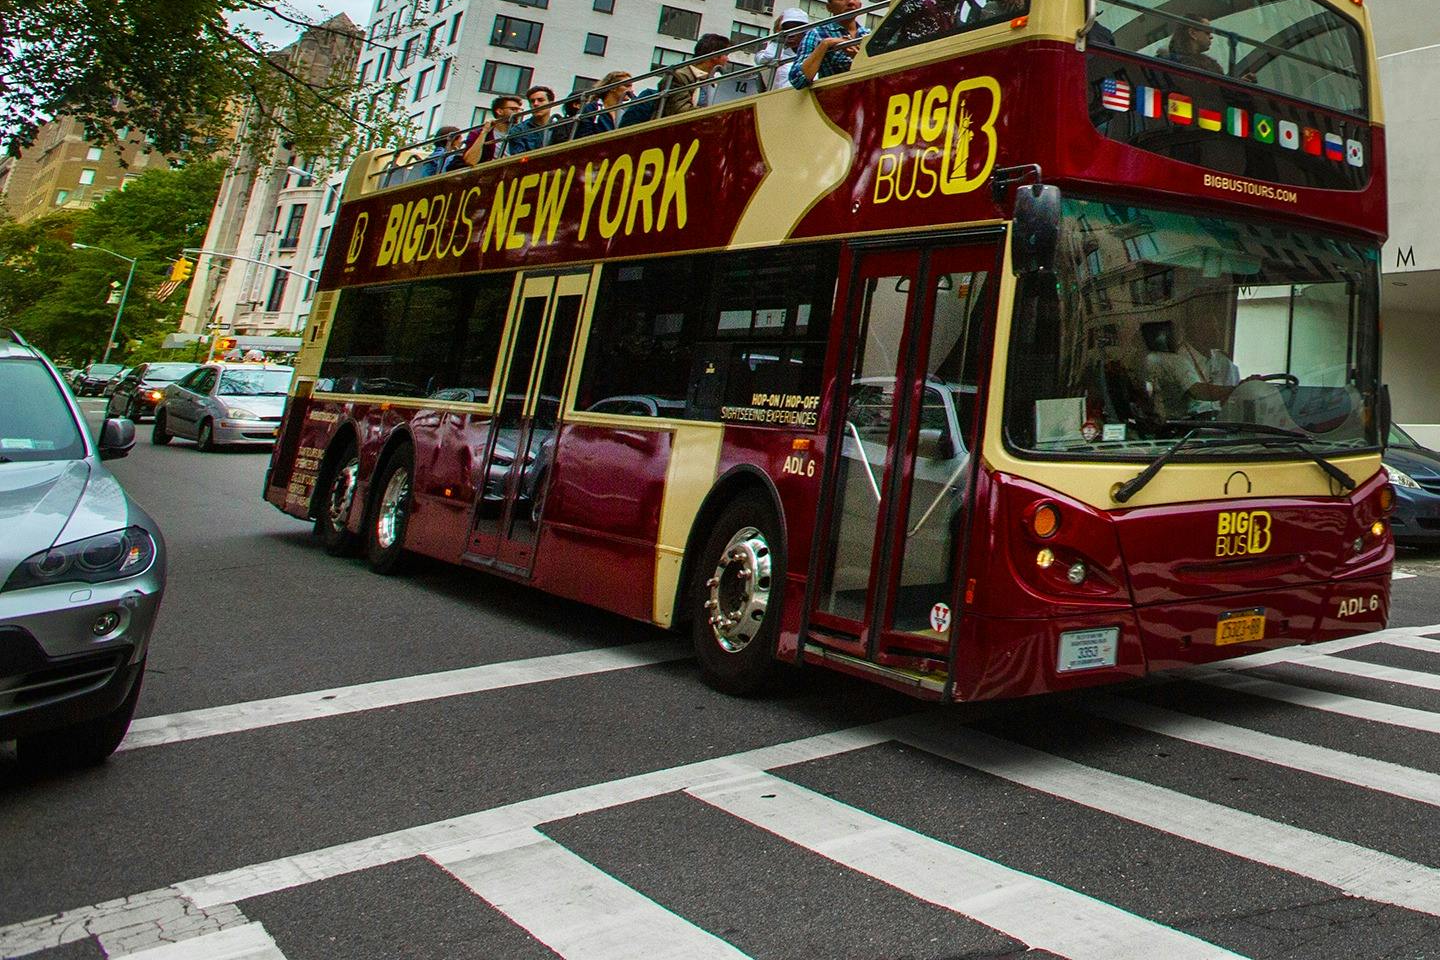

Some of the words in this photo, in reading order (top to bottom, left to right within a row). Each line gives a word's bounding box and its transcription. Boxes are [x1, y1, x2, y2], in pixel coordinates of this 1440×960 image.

[735, 81, 747, 93] 14
[881, 85, 948, 149] BIG
[873, 146, 939, 204] BUS
[482, 165, 575, 253] NEW
[577, 138, 699, 241] YORK
[1203, 174, 1297, 203] BIGBUSTOURS.COM
[1396, 245, 1415, 268] M
[752, 394, 780, 407] HOP-ON
[785, 395, 820, 409] HOP-OFF
[721, 407, 765, 422] SIGHTSEEING
[766, 410, 817, 426] EXPERIENCES
[783, 456, 805, 476] ADL
[807, 459, 815, 477] 6
[1217, 512, 1248, 535] BIG
[1216, 535, 1247, 556] BUS
[1337, 598, 1367, 618] ADL
[1369, 595, 1379, 611] 6
